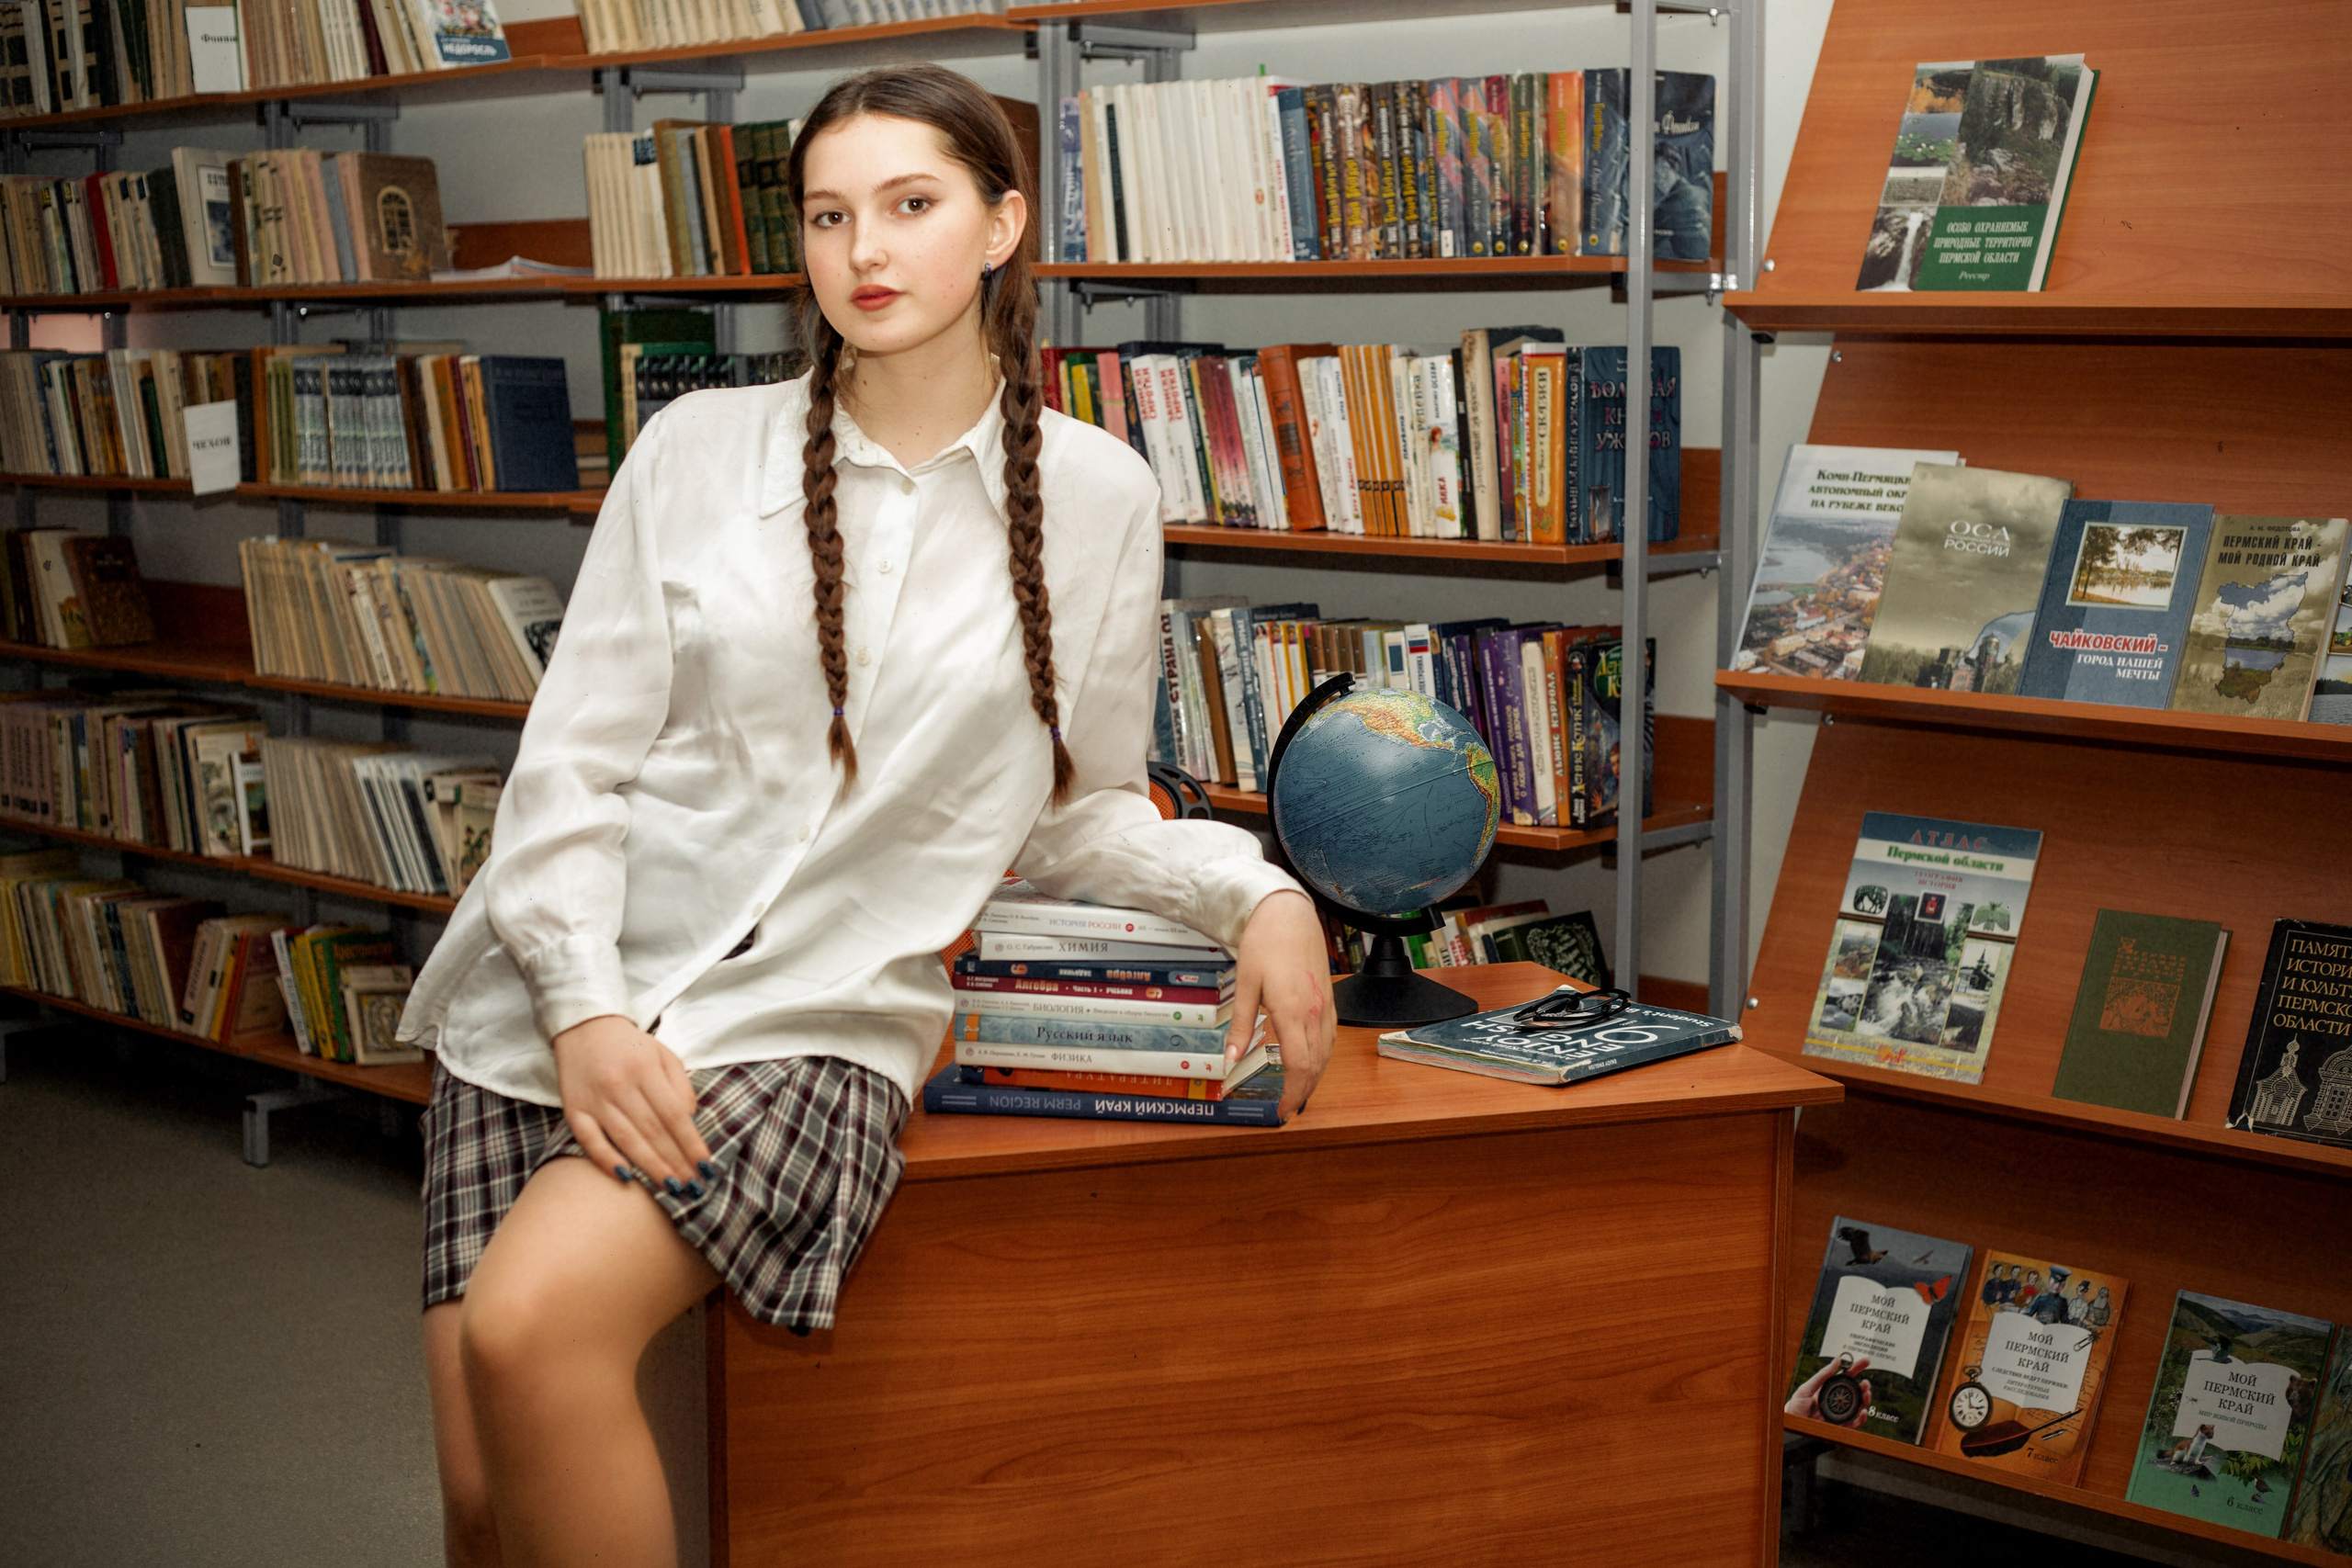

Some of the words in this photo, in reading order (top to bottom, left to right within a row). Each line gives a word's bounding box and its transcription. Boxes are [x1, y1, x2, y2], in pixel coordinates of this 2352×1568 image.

[1947, 221, 1972, 233] ОСОБО
[1974, 221, 2029, 232] ОХРАНЯЕМЫЕ
[1933, 237, 1981, 248] ПРИРОДНЫЕ
[1984, 236, 2033, 248] ТЕРРИТОРИИ
[1939, 251, 1980, 264] ПЕРМСКОЙ
[1984, 252, 2019, 264] ОБЛАСТИ
[1535, 370, 1548, 430] СКАЗКИ
[193, 436, 232, 451] ЧЕХОВ
[1810, 499, 1826, 509] НА
[1828, 500, 1872, 512] РУБЕЖЕ
[1875, 502, 1905, 513] ВЕКО
[1950, 520, 2011, 542] ОСА
[1943, 538, 2010, 558] РОССИИ
[2223, 536, 2279, 550] ПЕРМСКИЙ
[2284, 536, 2313, 550] КРАЙ
[2218, 552, 2242, 565] МОЙ
[2245, 552, 2288, 567] РОДНОЙ
[2290, 554, 2321, 568] КРАЙ
[2049, 629, 2158, 654] ЧАЙКОВСКИЙ
[2077, 654, 2114, 667] ГОРОД
[2117, 655, 2164, 670] НАШЕЙ
[2116, 667, 2160, 681] МЕЧТЫ
[1546, 671, 1560, 728] КЭРРОЛЛ
[1553, 732, 1565, 776] ЛЬЮИС
[1909, 829, 1988, 852] АТЛАС
[1887, 845, 1950, 866] Пермской
[1953, 856, 2004, 872] области
[1049, 919, 1086, 928] ИСТОРИЯ
[1088, 921, 1121, 930] РОССИИ
[1058, 942, 1108, 953] ХИМИЯ
[2290, 939, 2352, 961] ПАМЯТ
[1106, 969, 1151, 983] Алгебра
[2286, 958, 2352, 979] ИСТОРИ
[1015, 978, 1059, 992] Алгебра
[1105, 987, 1133, 996] УЧЕБНИК
[2282, 976, 2296, 989] И
[2299, 977, 2352, 999] КУЛЬТ
[1034, 1003, 1084, 1014] БИОЛОГИЯ
[2277, 995, 2352, 1018] ПЕРМСКО
[2273, 1013, 2350, 1036] ОБЛАСТИ
[1037, 1027, 1093, 1042] Русский
[1097, 1032, 1134, 1043] язык
[1471, 1034, 1598, 1058] ENJOY
[1051, 1053, 1092, 1064] ФИЗИКА
[1588, 1060, 1603, 1071] ENGLISH
[1603, 1058, 1617, 1069] ENJOY
[989, 1096, 1039, 1109] REGION
[1044, 1099, 1081, 1110] PERM
[1095, 1100, 1131, 1114] КРАЙ
[1136, 1101, 1214, 1116] ПЕРМСКИЙ
[1871, 1294, 1896, 1308] МОЙ
[1849, 1303, 1911, 1325] ПЕРМСКИЙ
[1861, 1319, 1892, 1335] КРАЙ
[2028, 1331, 2054, 1346] МОЙ
[2005, 1340, 2070, 1363] ПЕРМСКИЙ
[2018, 1357, 2050, 1373] КРАЙ
[1992, 1366, 2022, 1378] СЛЕДСТВИЕ
[2023, 1373, 2041, 1382] ВЕДУТ
[2228, 1371, 2258, 1387] МОЙ
[2003, 1385, 2050, 1400] РАССЛЕДОВАНИЯ
[2006, 1379, 2050, 1393] ЛИТЕРАТУРНЫЕ
[2203, 1381, 2275, 1406] ПЕРМСКИЙ
[1868, 1404, 1876, 1417] 8
[1875, 1410, 1899, 1424] класс
[2218, 1397, 2255, 1416] КРАЙ
[2198, 1409, 2212, 1417] МИР
[2212, 1411, 2236, 1424] ЖИВОЙ
[2235, 1417, 2267, 1430] ПРИРОДЫ
[2025, 1446, 2034, 1459] 7
[2033, 1452, 2059, 1465] класс
[2226, 1496, 2234, 1507] 6
[2236, 1501, 2264, 1515] класс
